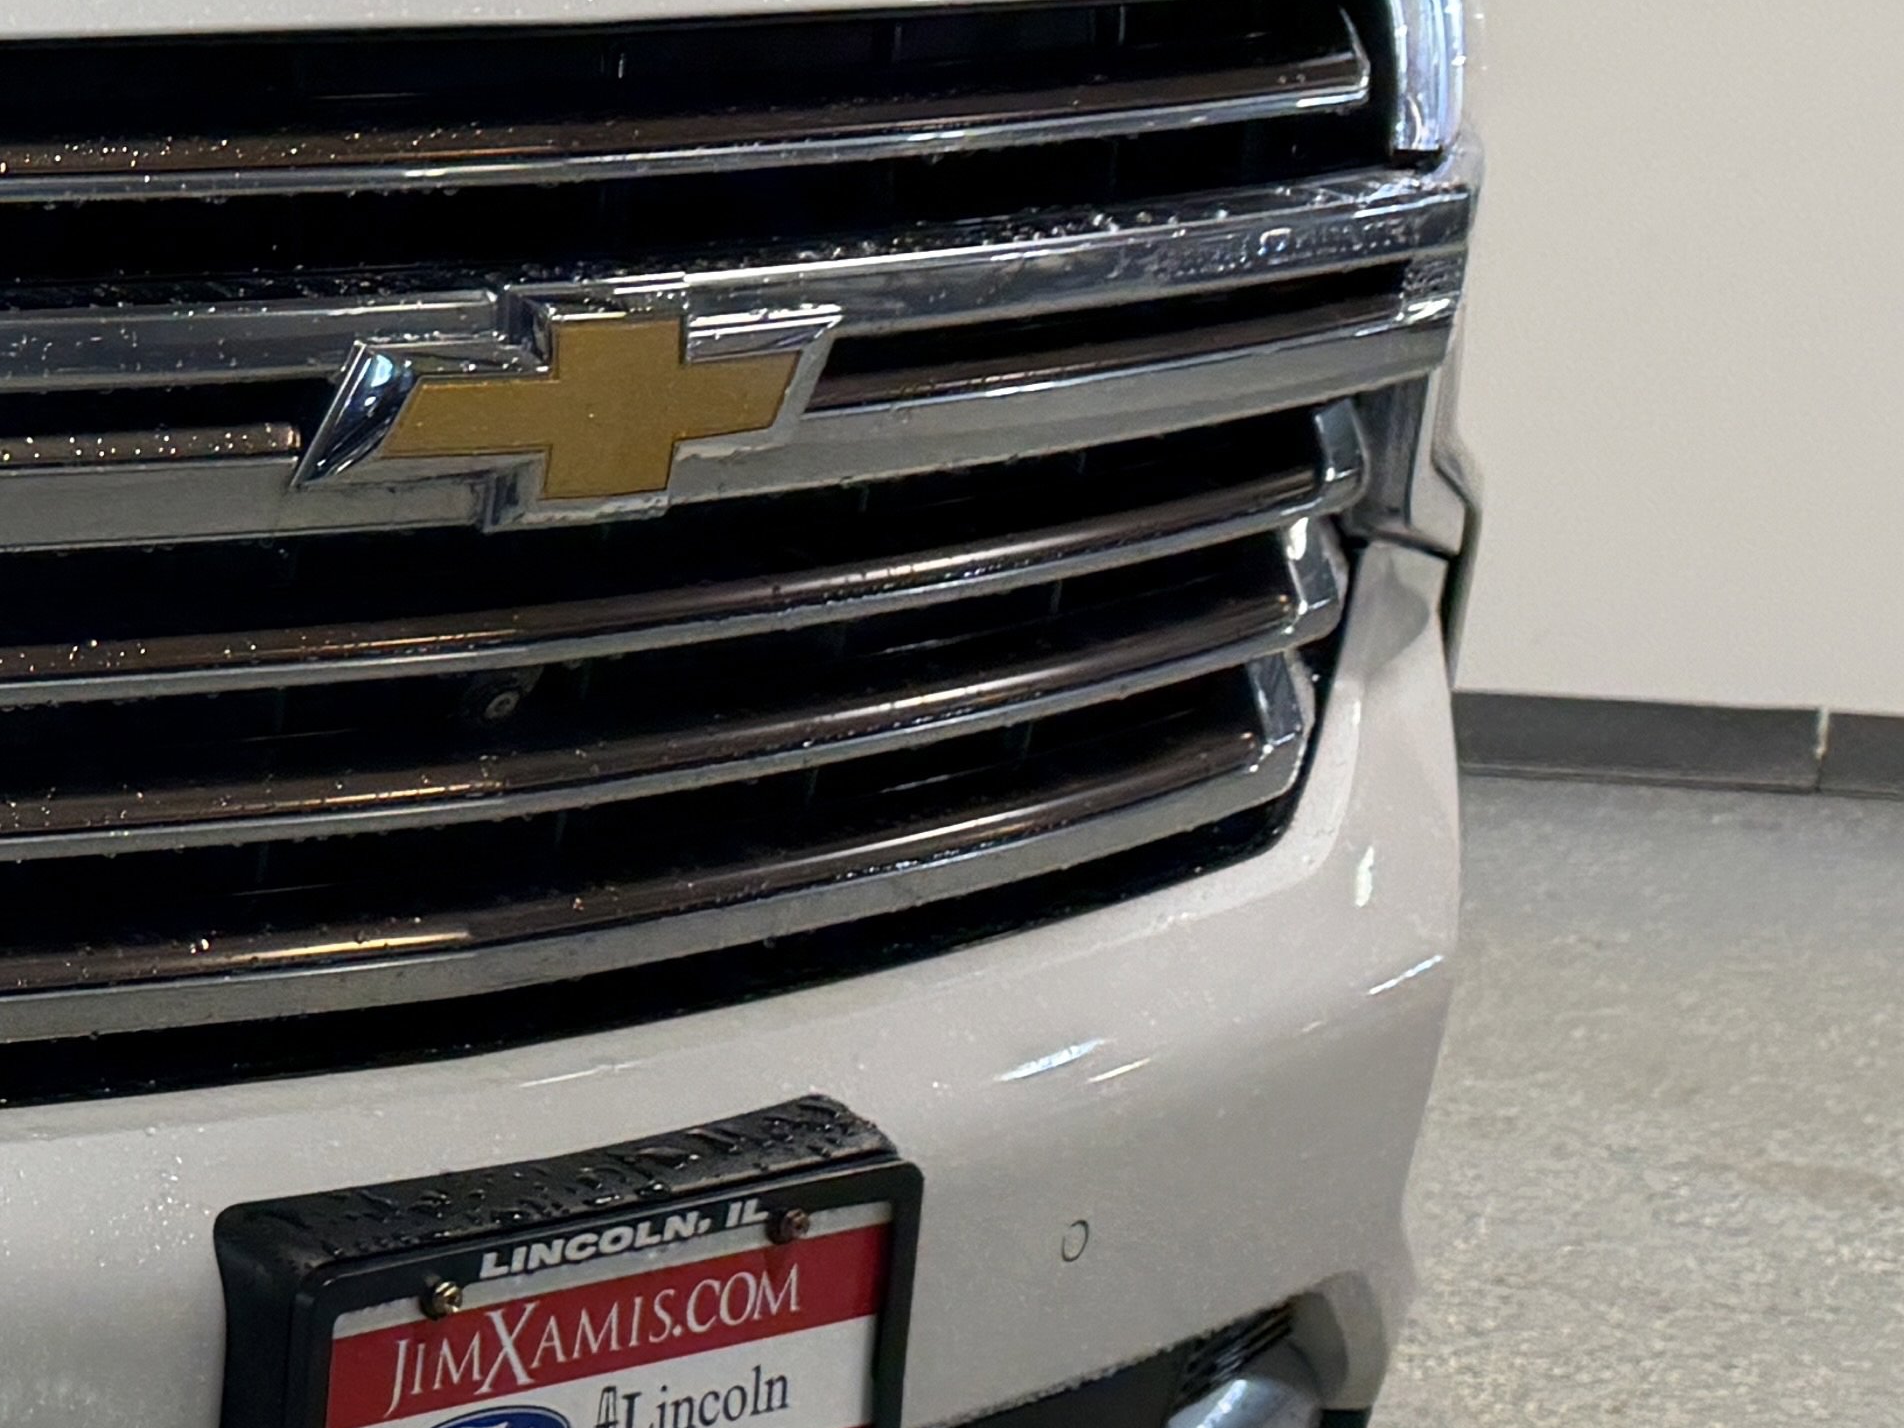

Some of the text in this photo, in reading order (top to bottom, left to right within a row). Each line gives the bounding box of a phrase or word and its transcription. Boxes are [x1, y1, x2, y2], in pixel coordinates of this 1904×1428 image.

[479, 1198, 769, 1279] LINCOLN, IL
[384, 1262, 801, 1419] JIMXAMIS.COM
